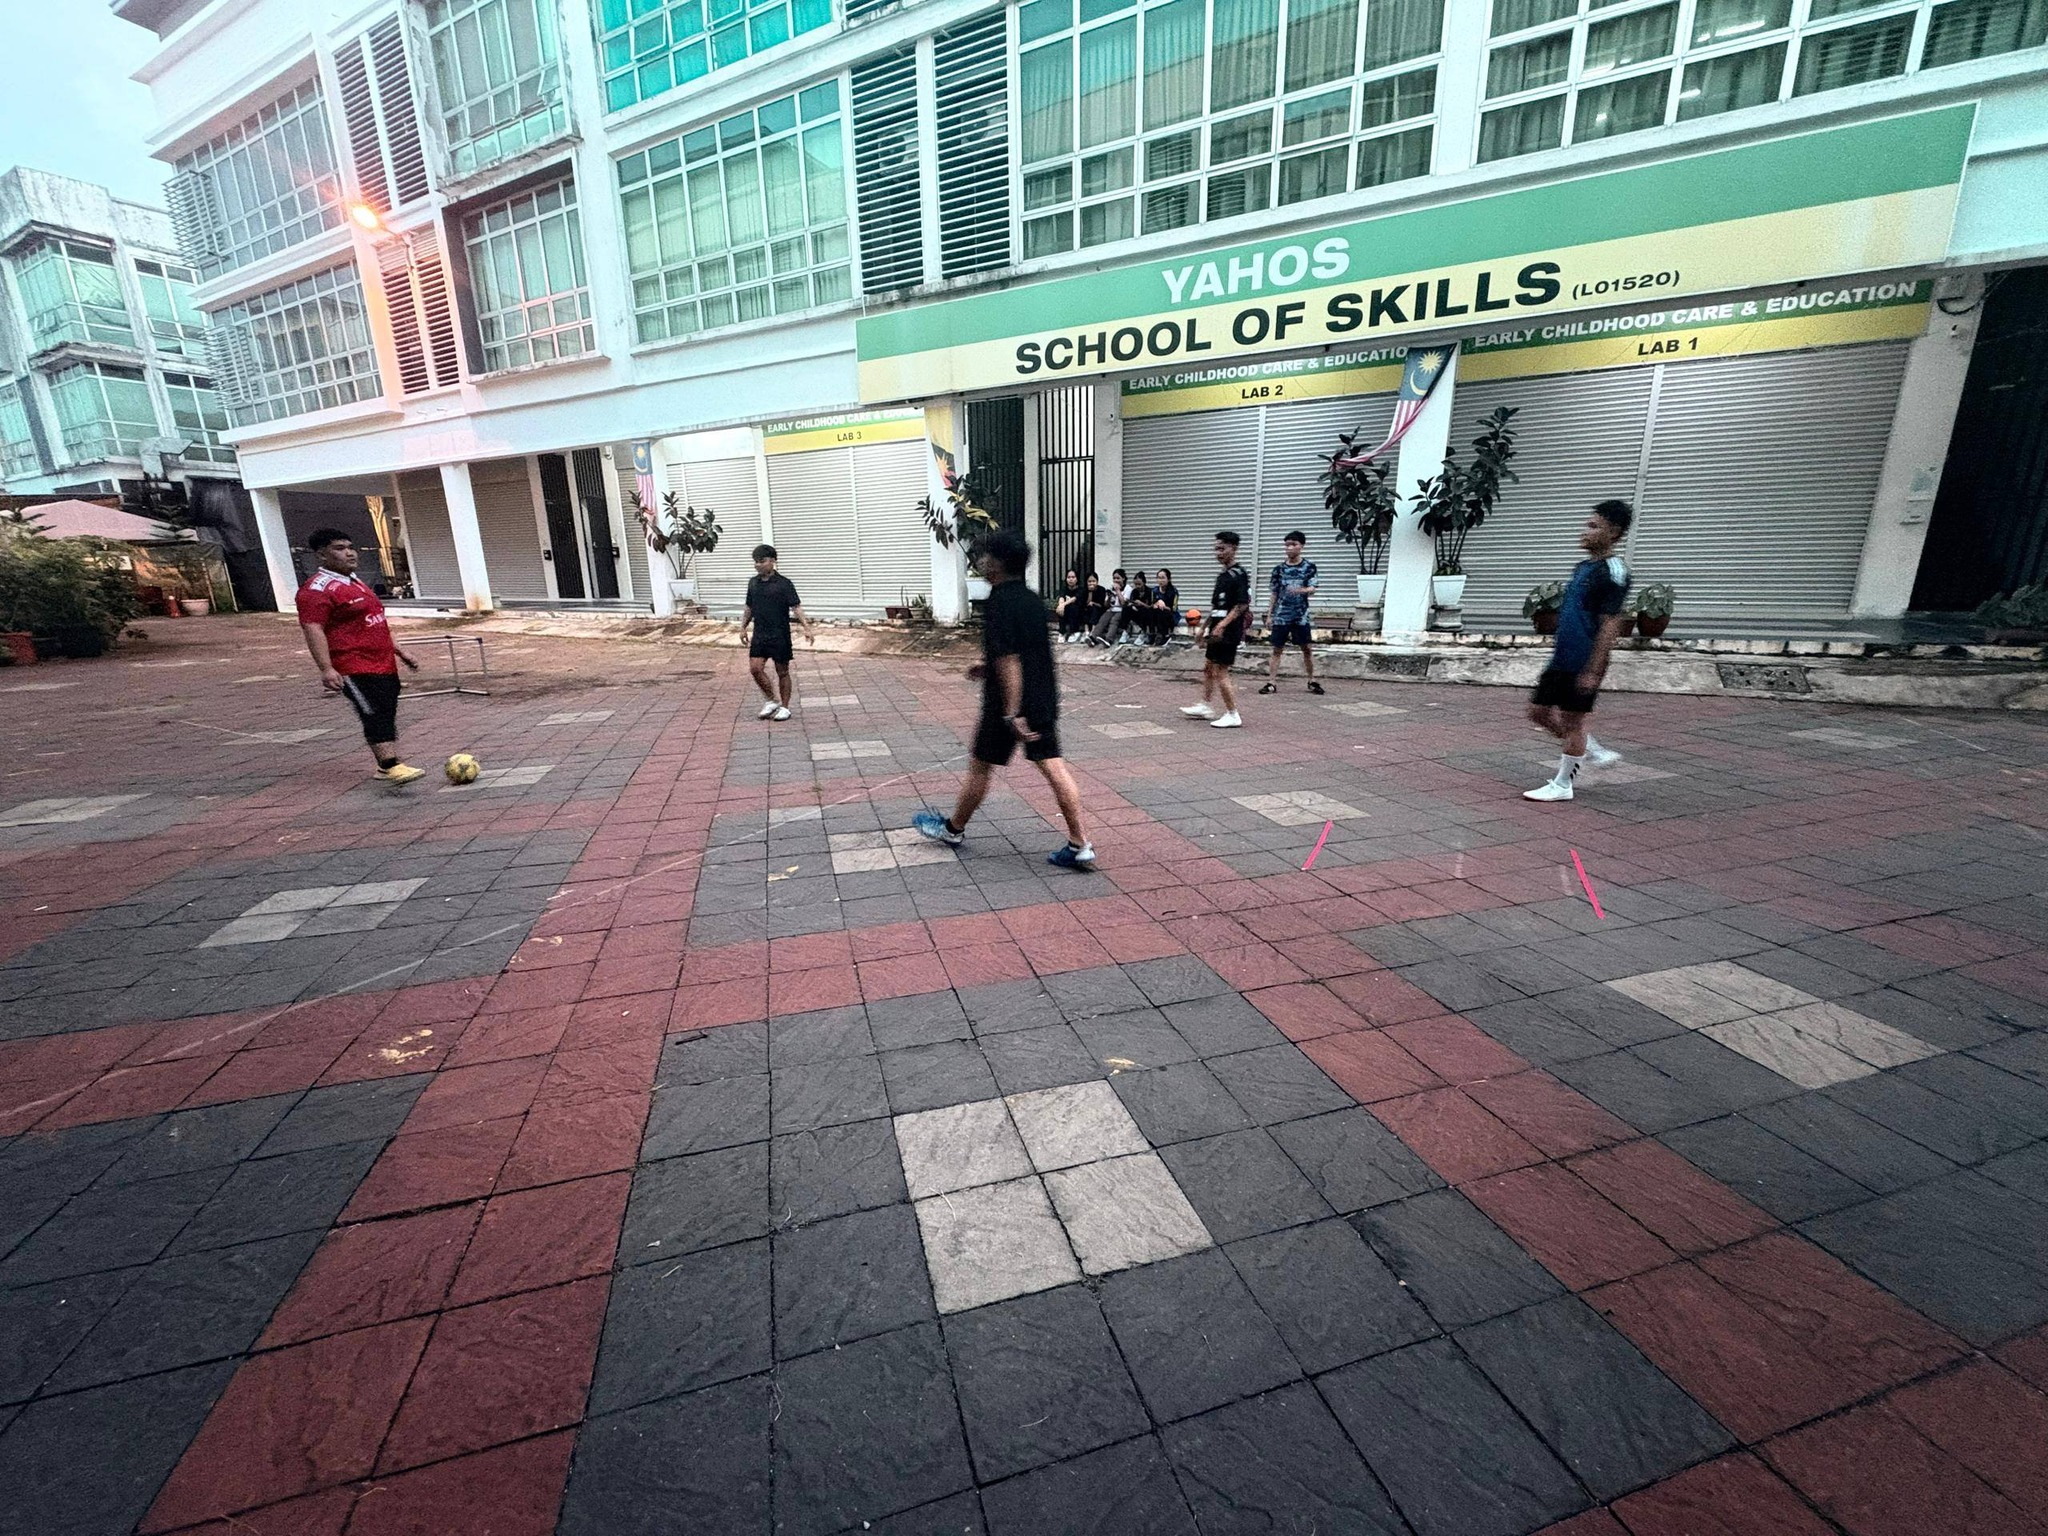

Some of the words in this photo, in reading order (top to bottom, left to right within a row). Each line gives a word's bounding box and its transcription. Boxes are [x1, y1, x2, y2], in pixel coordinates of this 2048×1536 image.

[1162, 238, 1350, 304] YAHOS
[1016, 318, 1212, 374] SCHOOL
[1232, 301, 1306, 345] OF
[1325, 262, 1561, 332] SKILLS
[1475, 328, 1536, 347] EARLY
[1541, 311, 1665, 340] CHILDHOOD
[1671, 303, 1733, 324] CARE
[1741, 301, 1758, 316] &
[1766, 281, 1917, 314] EDUCATION
[1637, 339, 1680, 356] LAB
[1688, 337, 1698, 350] 1
[1129, 374, 1171, 389] EARLY
[1175, 365, 1258, 384] CHILDHOOD
[1262, 359, 1303, 373] CARE
[1308, 358, 1319, 369] &
[1324, 346, 1408, 367] EDUCATIO
[1242, 386, 1269, 399] LAB
[1275, 385, 1283, 396] 2
[767, 422, 793, 433] EARLY
[795, 415, 846, 430] CHILDHOOD
[837, 432, 854, 442] LAB
[857, 431, 862, 440] 3
